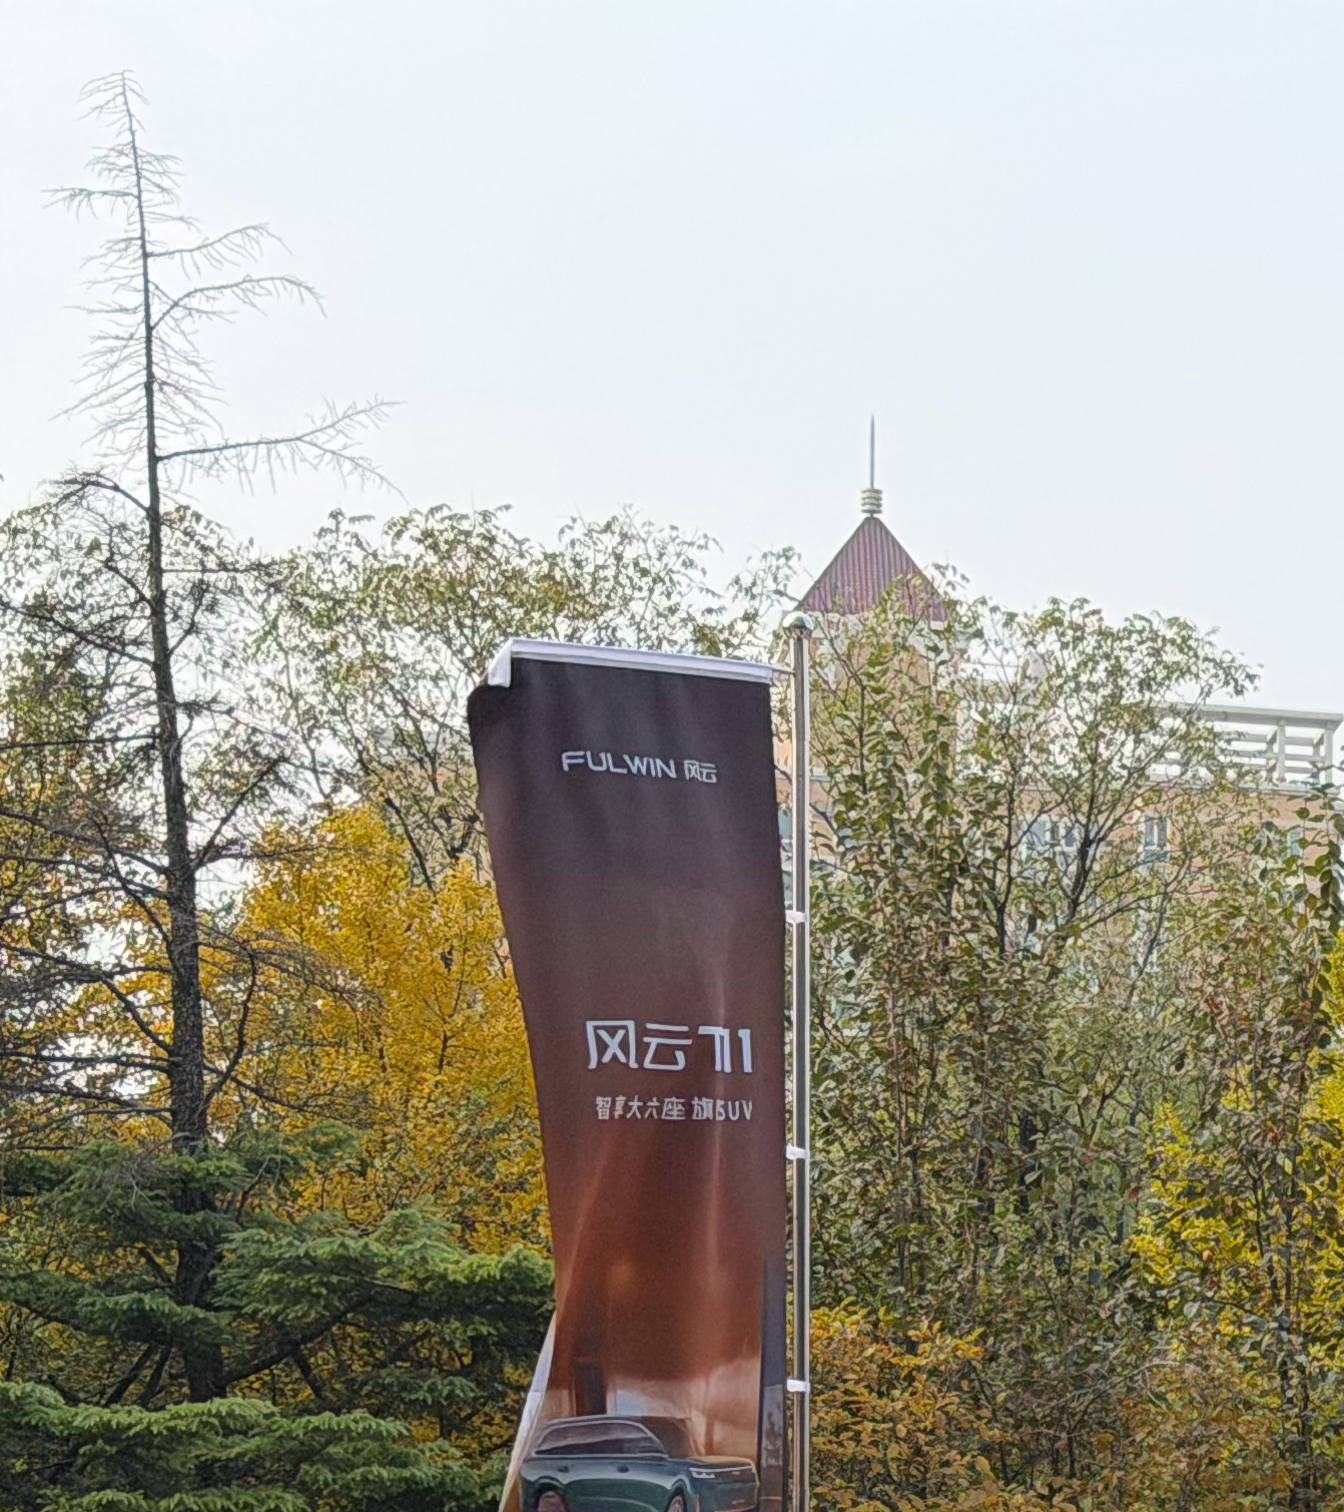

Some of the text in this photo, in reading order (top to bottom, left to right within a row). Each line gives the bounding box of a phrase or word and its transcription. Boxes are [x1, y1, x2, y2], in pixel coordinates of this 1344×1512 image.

[561, 750, 718, 784] FULWIN 风云
[585, 1019, 753, 1074] 风云T11
